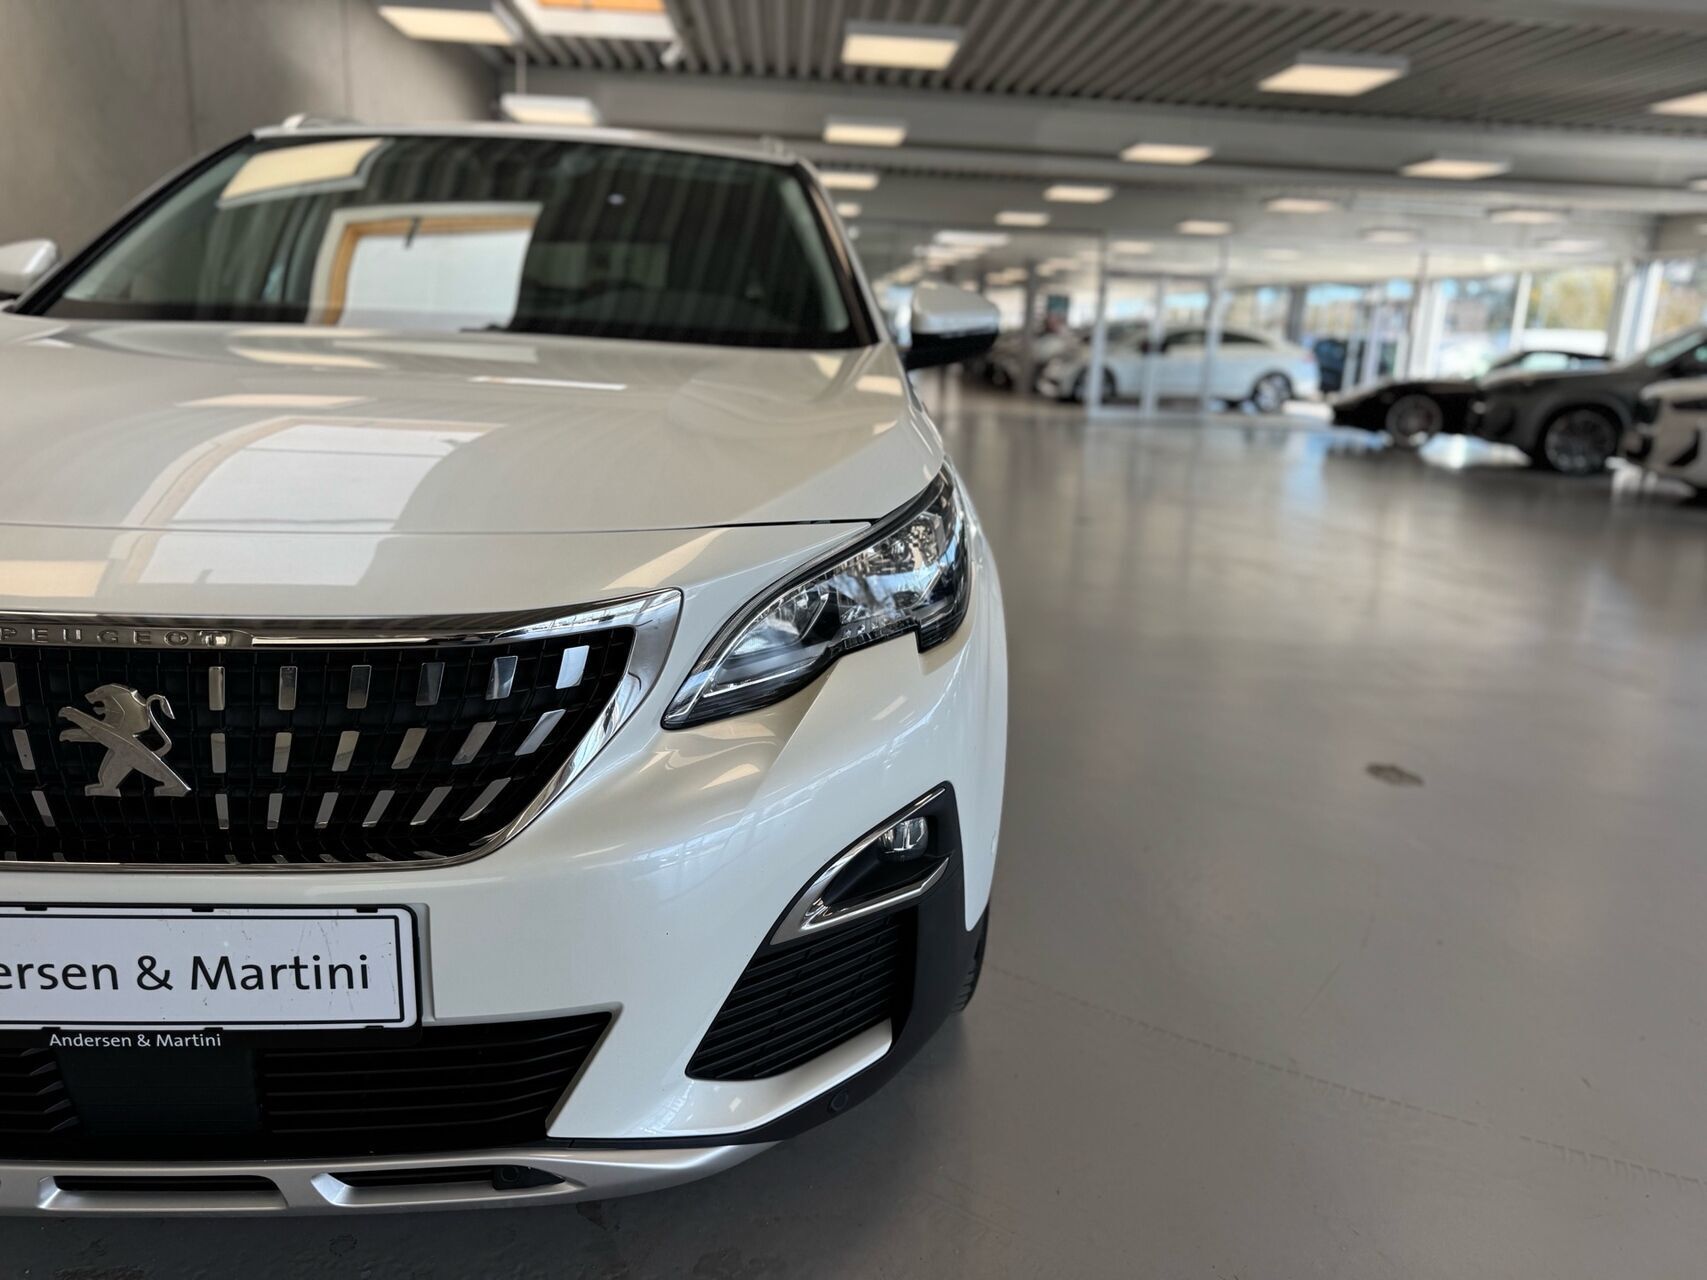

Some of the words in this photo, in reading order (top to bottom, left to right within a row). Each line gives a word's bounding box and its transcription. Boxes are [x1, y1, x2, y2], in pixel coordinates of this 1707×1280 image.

[137, 955, 173, 990] &
[192, 955, 369, 990] Martini
[50, 1033, 132, 1047] Andersen
[137, 1033, 151, 1047] &
[156, 1033, 221, 1047] Martini
